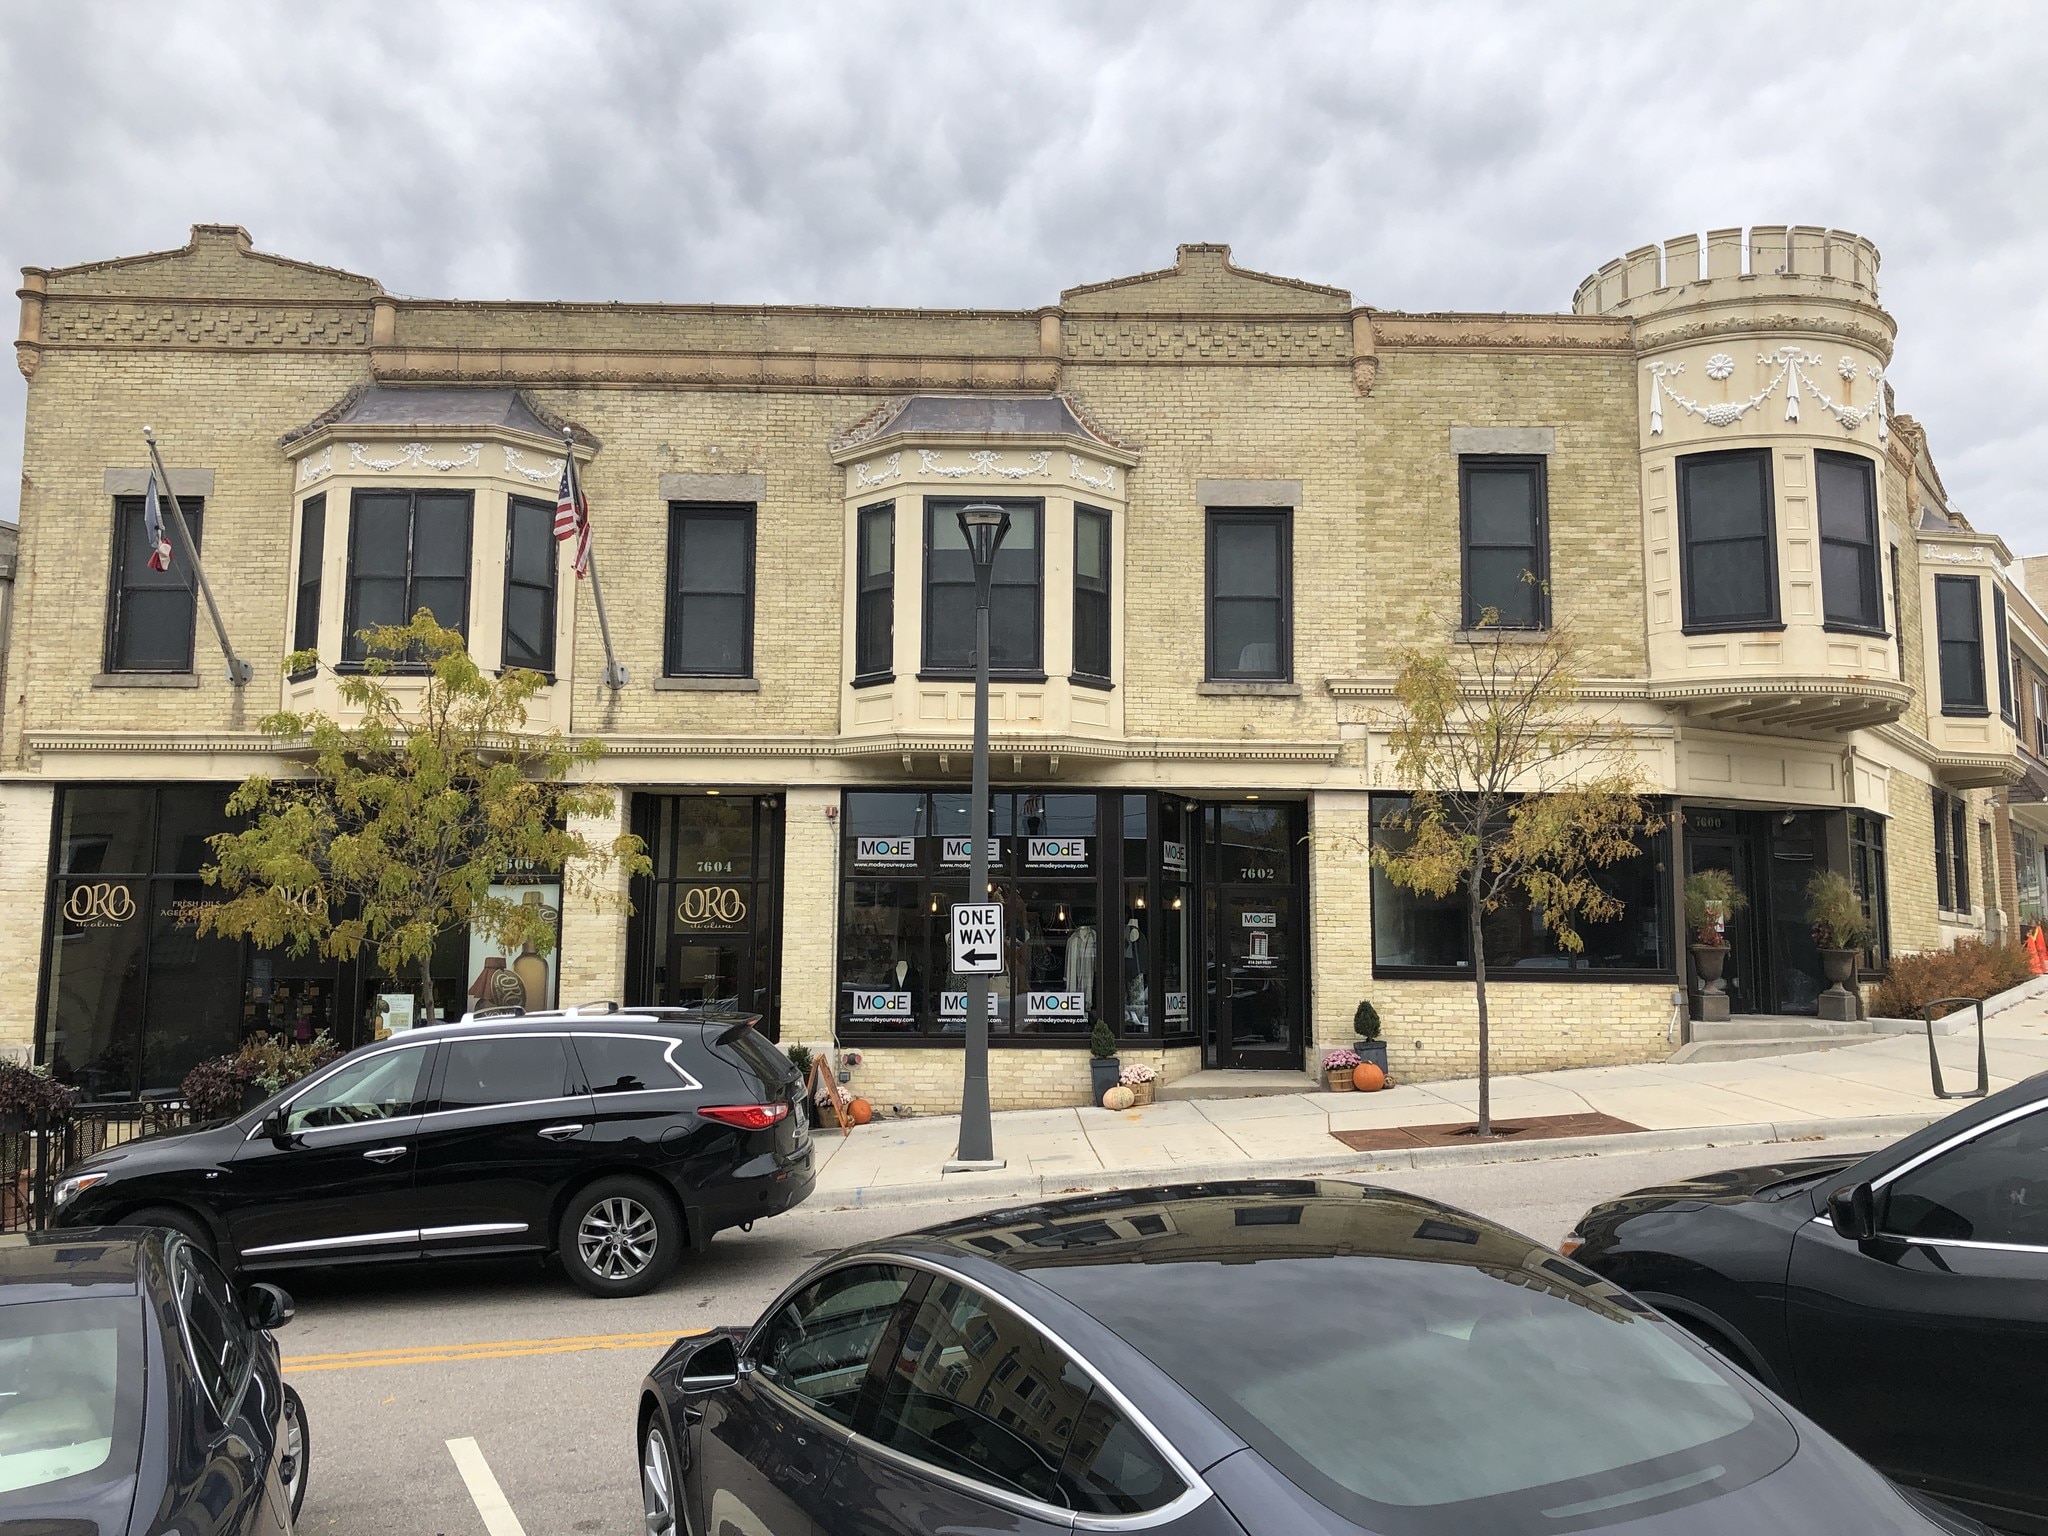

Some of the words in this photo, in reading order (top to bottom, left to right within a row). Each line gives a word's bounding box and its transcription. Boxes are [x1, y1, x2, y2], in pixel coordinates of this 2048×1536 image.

[1695, 816, 1722, 828] 7600
[947, 841, 997, 856] MOE
[697, 861, 732, 873] 7604
[854, 861, 918, 869] www.modeyourway.com
[1241, 868, 1275, 879] 7602
[63, 883, 136, 922] ORO
[201, 900, 221, 908] OILS
[678, 886, 747, 924] ORO
[959, 910, 995, 925] ONE
[960, 929, 997, 944] WAY
[944, 995, 995, 1010] MOE
